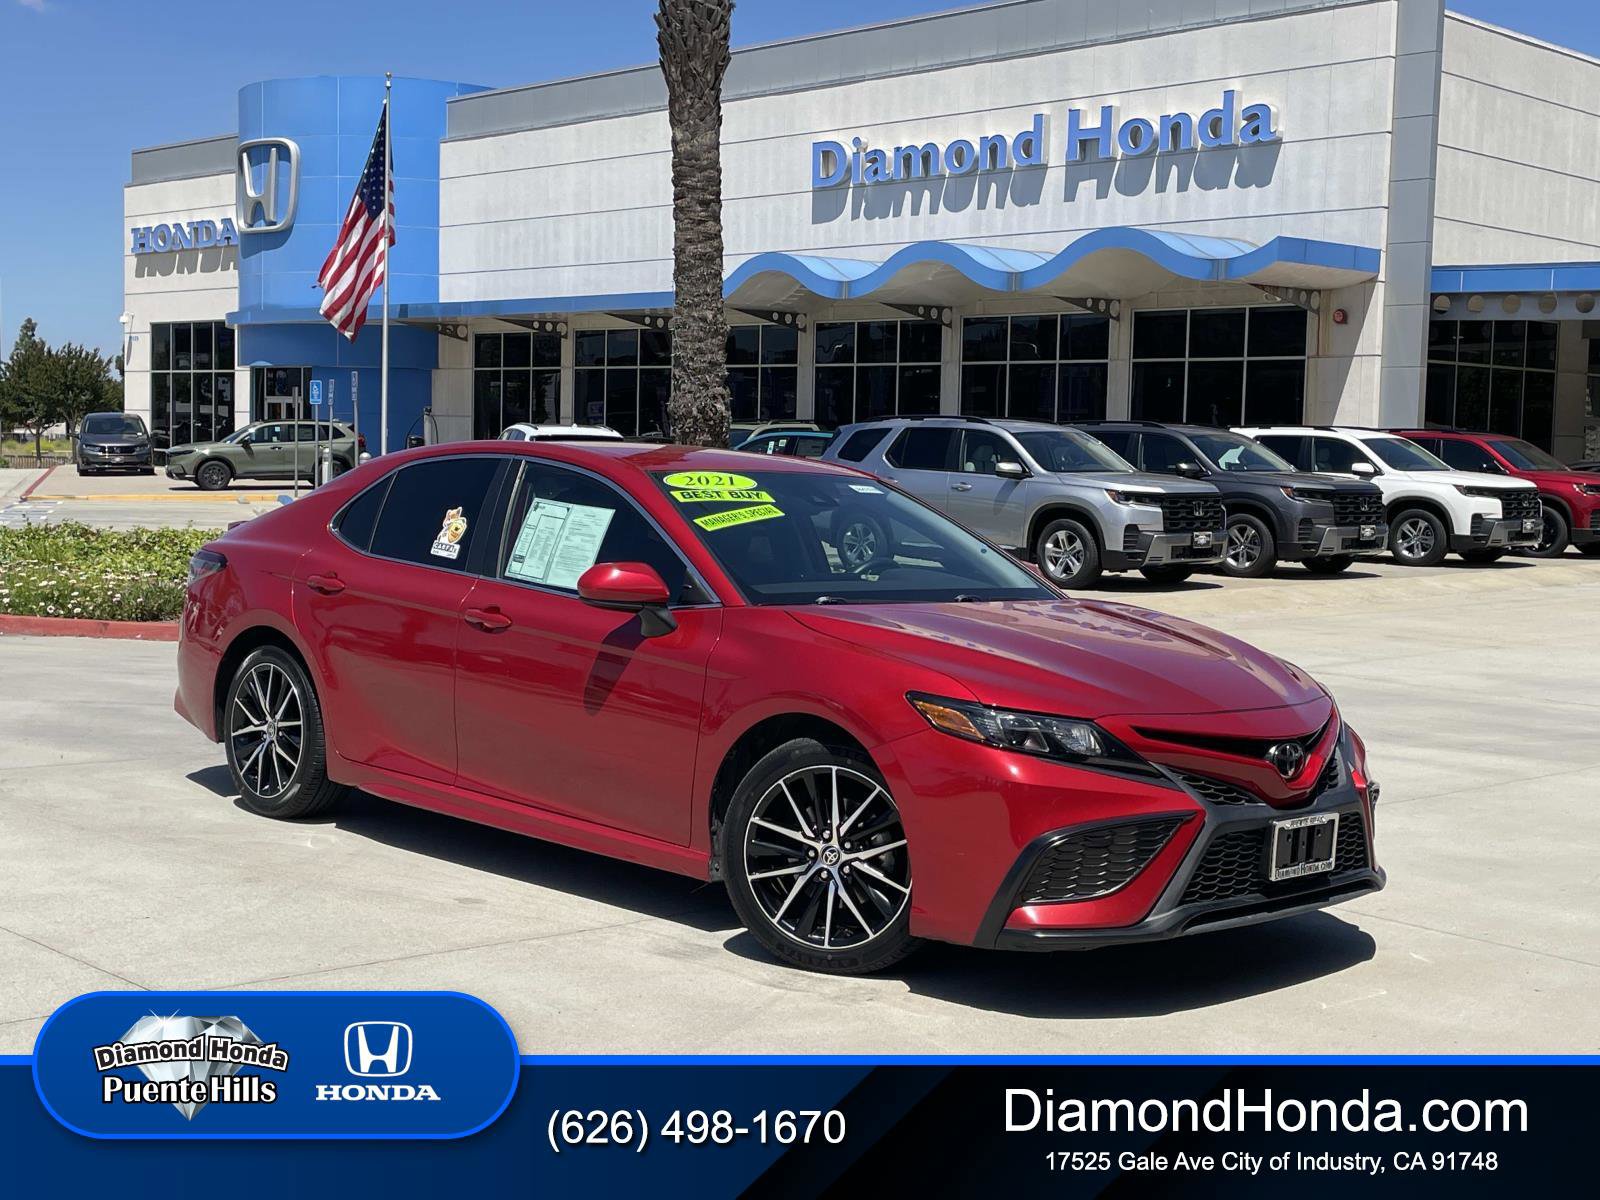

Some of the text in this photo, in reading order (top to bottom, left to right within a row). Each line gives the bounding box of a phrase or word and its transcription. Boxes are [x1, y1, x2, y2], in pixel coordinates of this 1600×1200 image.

[811, 88, 1279, 189] Diamond Honda
[131, 217, 239, 254] HONDA
[684, 475, 736, 486] 2021
[680, 490, 763, 500] BEST BUY
[700, 505, 779, 529] MANAGER'S SPECIAL
